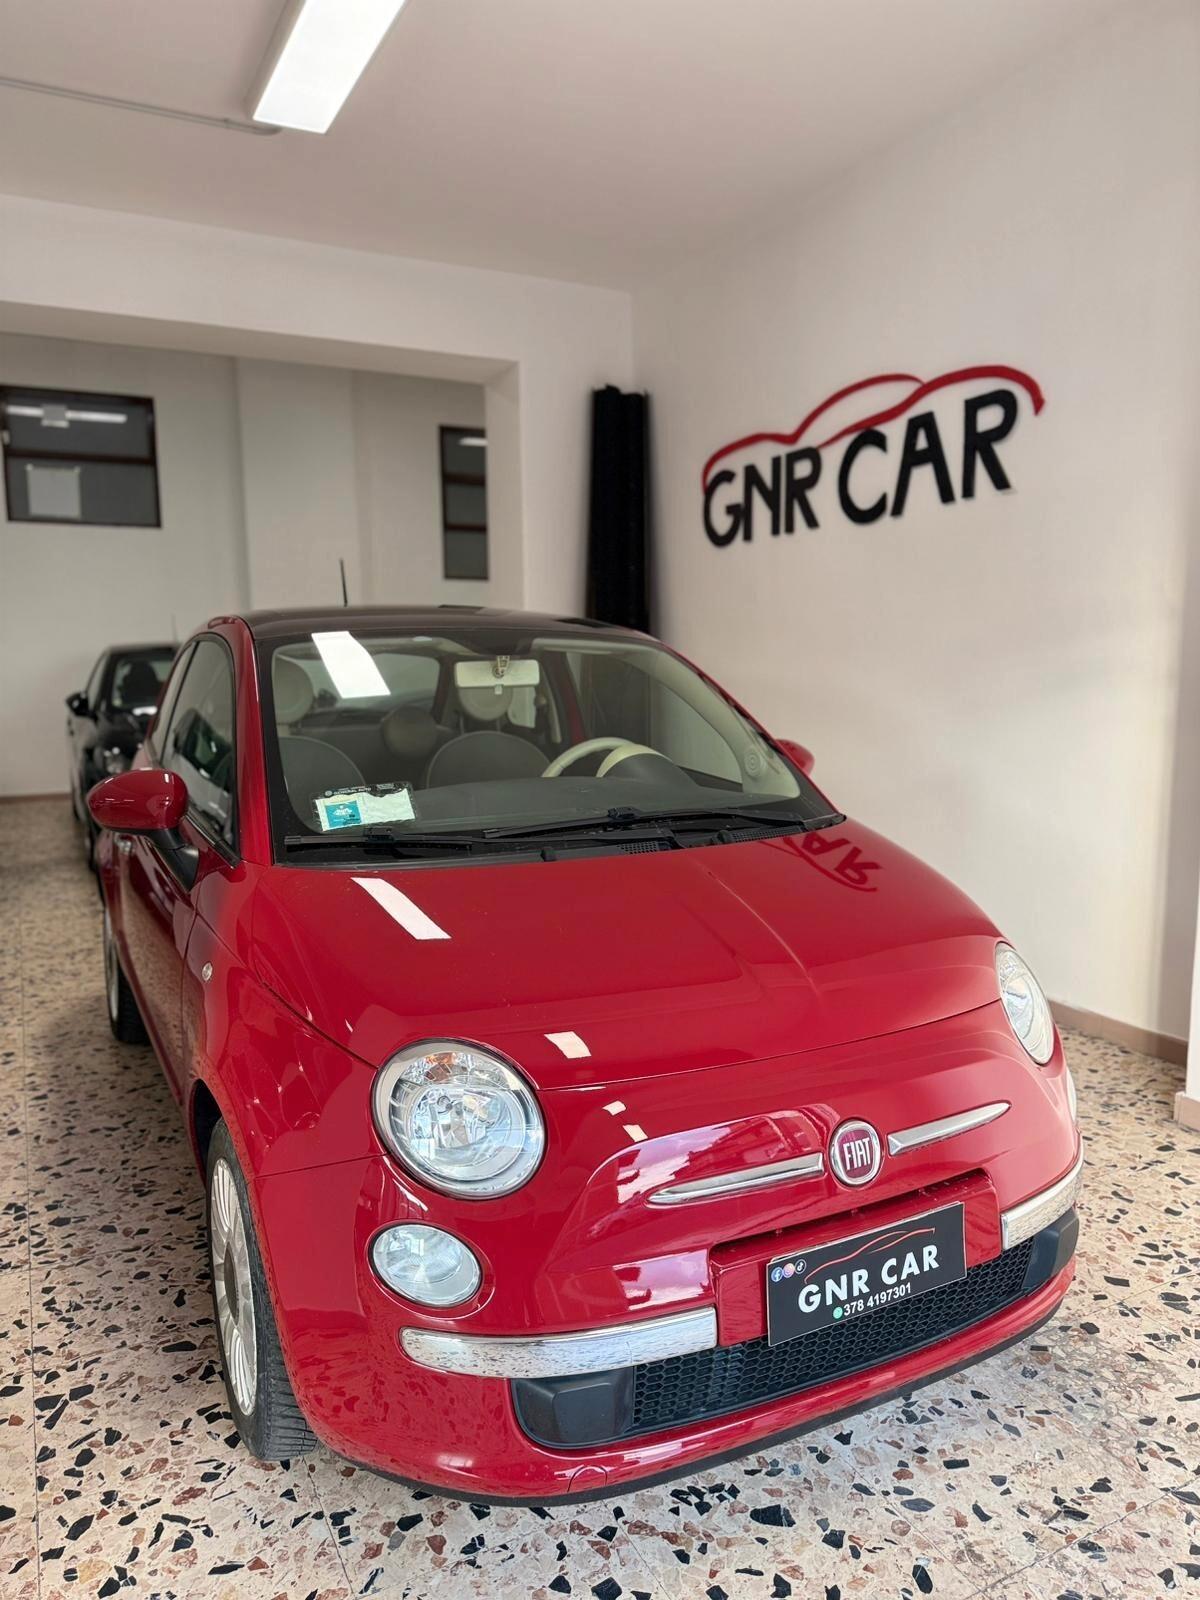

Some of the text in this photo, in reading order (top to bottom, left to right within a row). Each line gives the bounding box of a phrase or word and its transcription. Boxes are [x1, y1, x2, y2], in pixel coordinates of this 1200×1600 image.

[704, 389, 1018, 547] GNR CAR
[843, 1137, 871, 1171] FIAT
[798, 1244, 940, 1313] GNR CAR
[843, 1282, 912, 1316] 378 4197301
